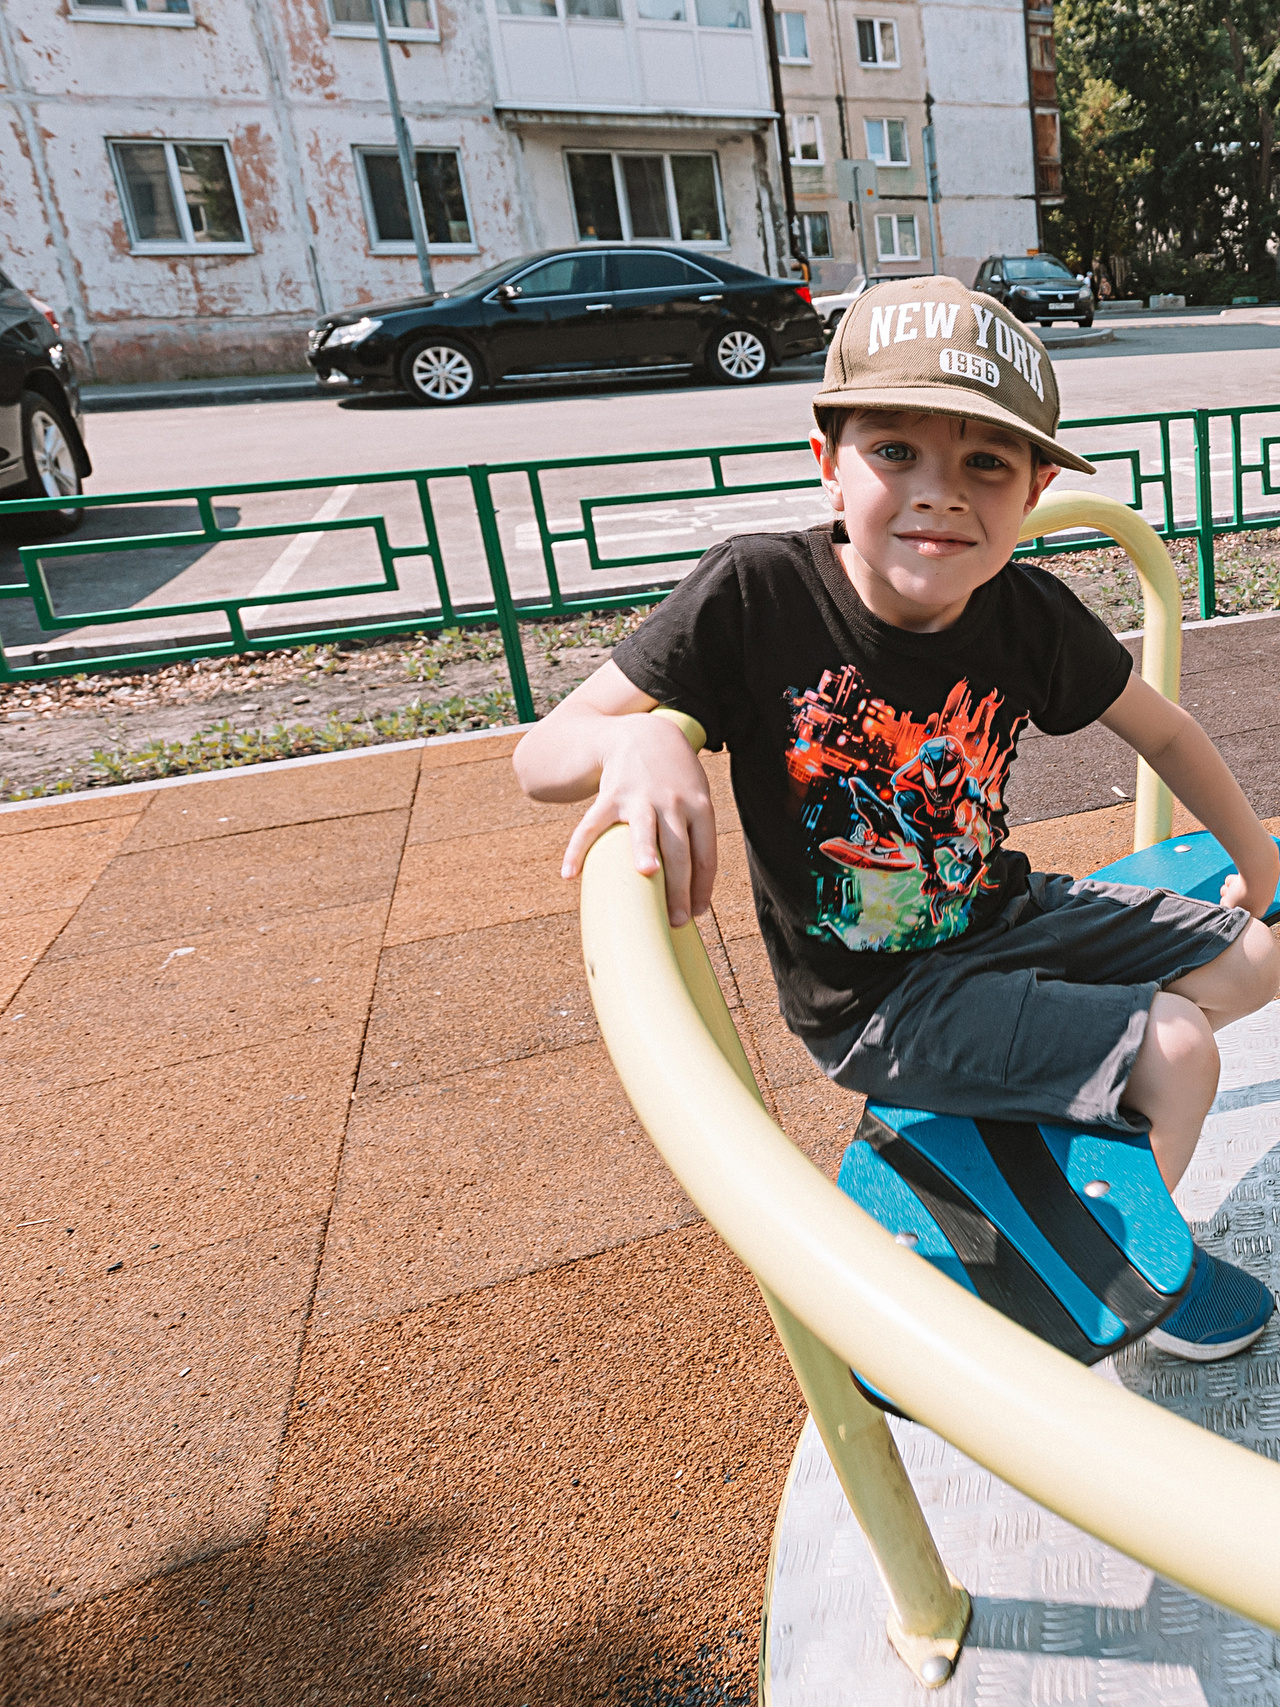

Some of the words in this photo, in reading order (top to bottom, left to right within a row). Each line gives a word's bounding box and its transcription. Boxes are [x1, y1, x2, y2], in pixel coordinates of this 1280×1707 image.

[867, 301, 961, 357] NEW
[970, 302, 1045, 403] YORK
[945, 349, 995, 384] 1956
